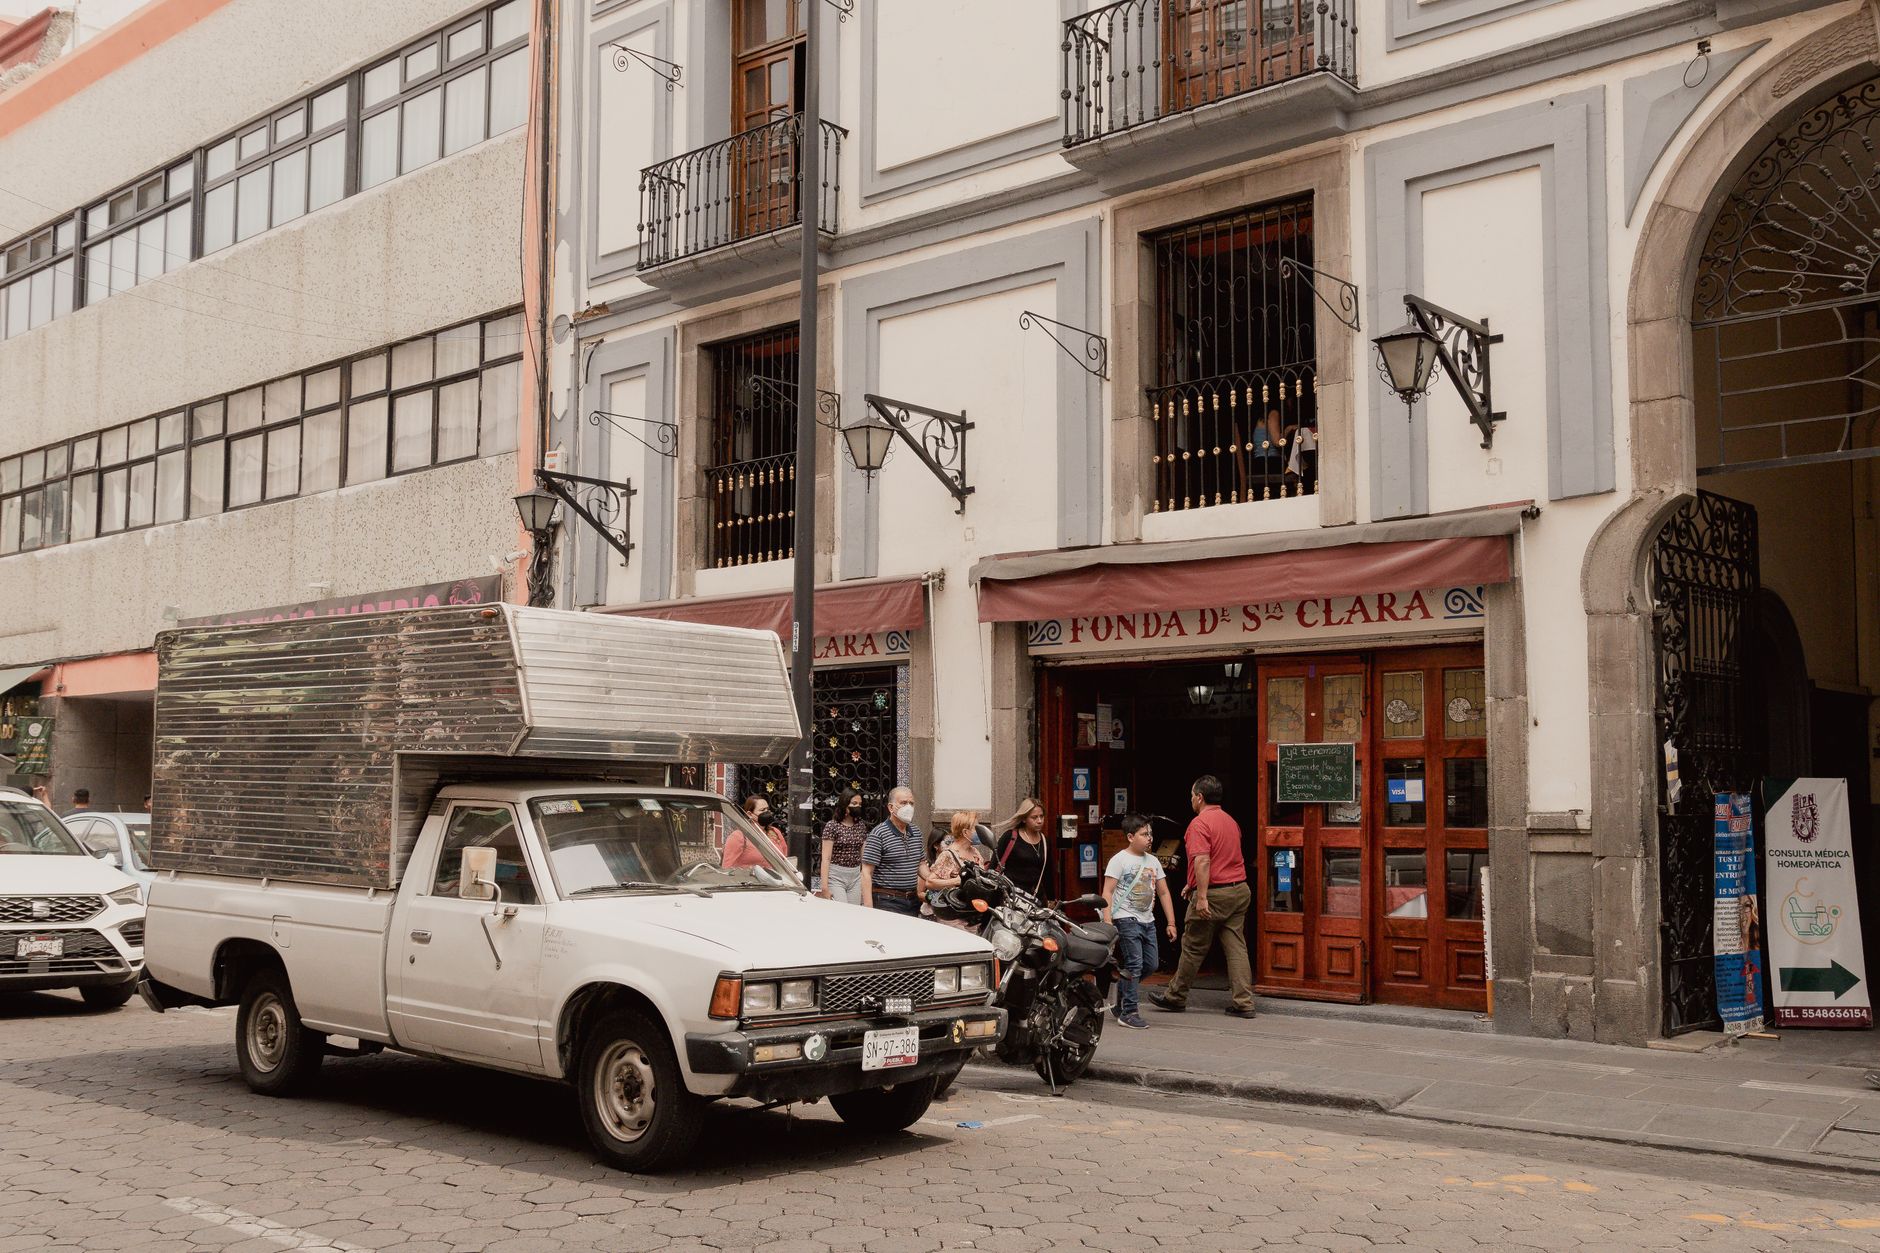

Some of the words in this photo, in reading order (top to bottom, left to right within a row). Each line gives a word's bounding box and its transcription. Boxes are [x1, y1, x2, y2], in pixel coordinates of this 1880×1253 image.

[1070, 610, 1188, 643] FONDA
[1295, 590, 1434, 628] CLARA
[813, 632, 880, 659] LARA
[1768, 849, 1813, 858] CONSULTA
[1814, 848, 1850, 858] MÉDICA
[1777, 859, 1841, 869] HOMEOPÁTICA
[1779, 1008, 1799, 1018] TEL.
[1802, 1008, 1868, 1018] 5548636154
[866, 1039, 916, 1058] SN-97-386
